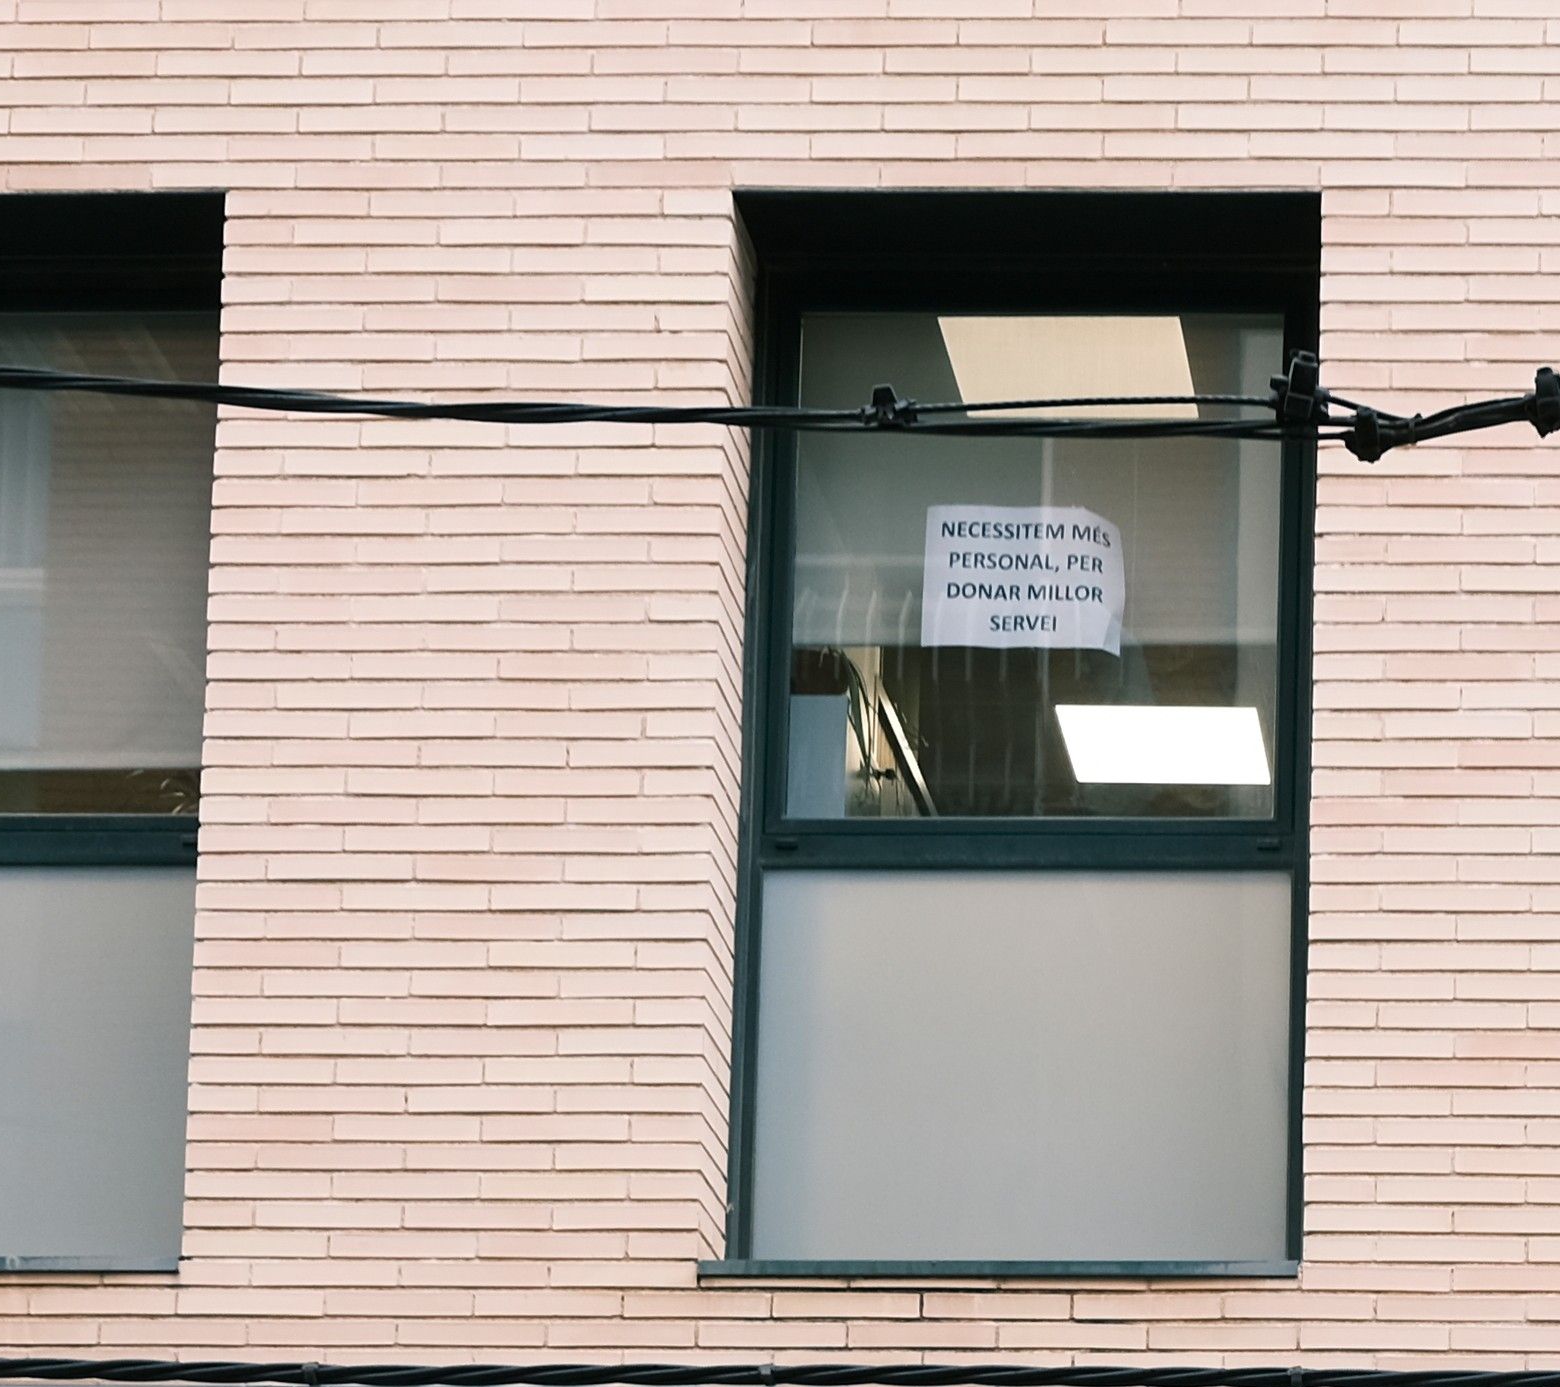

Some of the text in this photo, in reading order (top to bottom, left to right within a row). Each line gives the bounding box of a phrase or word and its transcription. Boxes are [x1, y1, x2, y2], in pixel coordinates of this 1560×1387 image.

[941, 521, 1111, 547] NECESSITEM MÉS
[949, 553, 1103, 573] PERSONAL, PER
[947, 583, 1103, 603] DONAR MILLOR
[990, 615, 1056, 631] SERVEI
